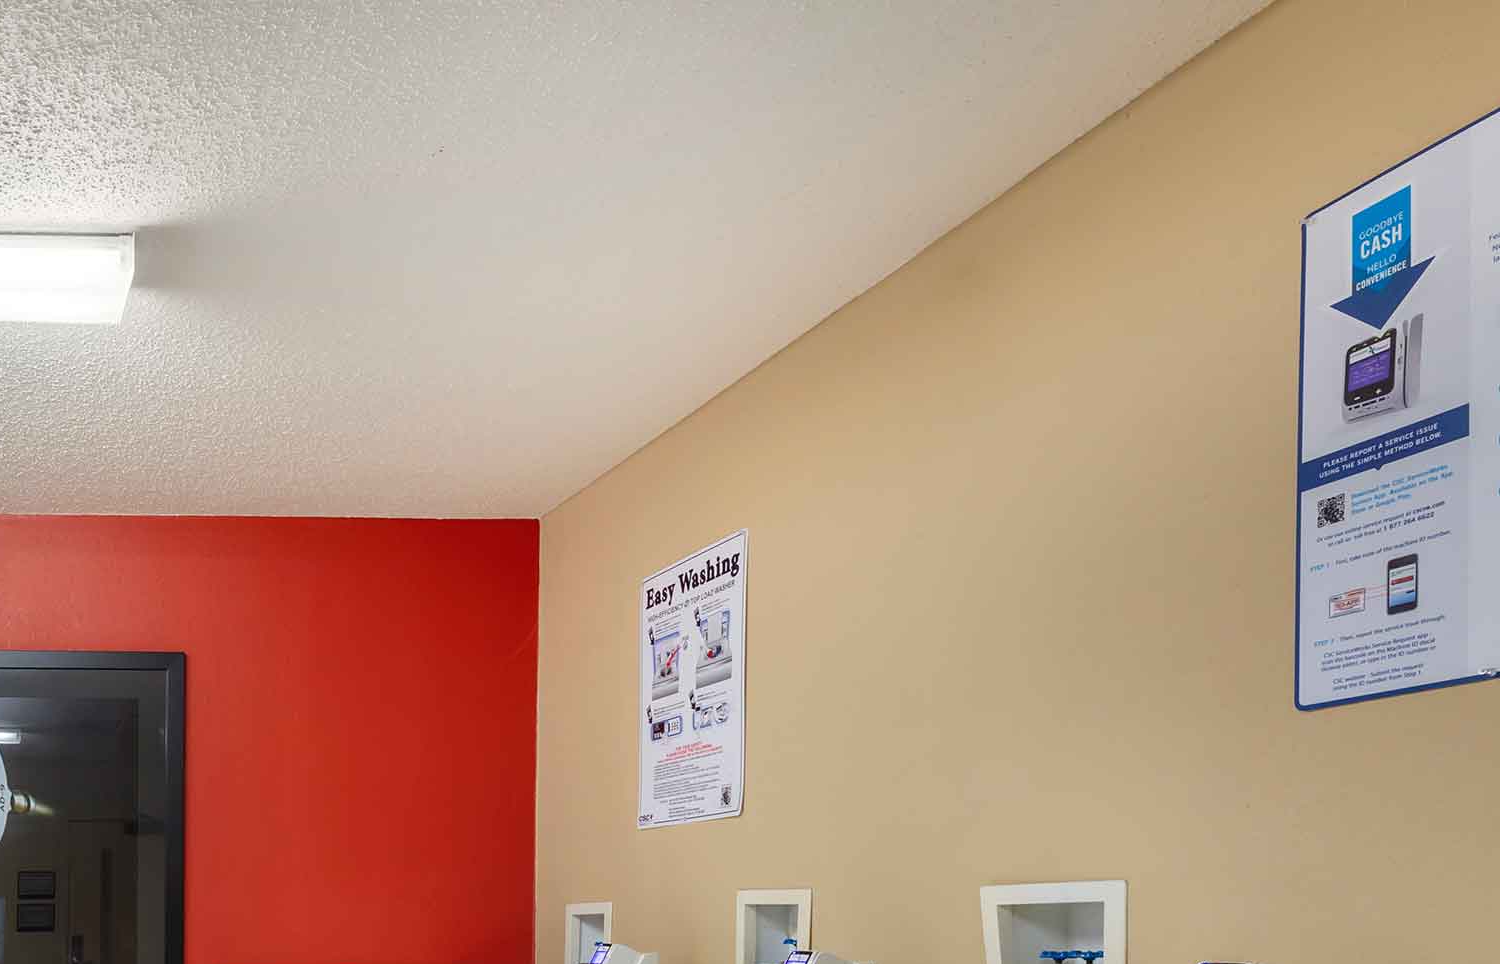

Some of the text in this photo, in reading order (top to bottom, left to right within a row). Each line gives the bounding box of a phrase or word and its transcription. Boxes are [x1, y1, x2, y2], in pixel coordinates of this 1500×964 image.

[1359, 211, 1404, 240] GOODBYE
[1360, 223, 1402, 259] CASH
[1356, 260, 1408, 291] CONVENIENCE
[1367, 254, 1397, 274] HELLO
[1319, 467, 1340, 479] USING
[1342, 462, 1355, 472] THE
[1356, 453, 1382, 466] SIMPLE
[1384, 442, 1414, 457] METHOD
[1323, 454, 1349, 468] PLEASE
[1350, 445, 1376, 459] REPORT
[1385, 432, 1414, 447] SERVICE
[1416, 423, 1438, 436] ISSUE
[645, 583, 676, 610] Easy
[678, 552, 741, 594] Washing
